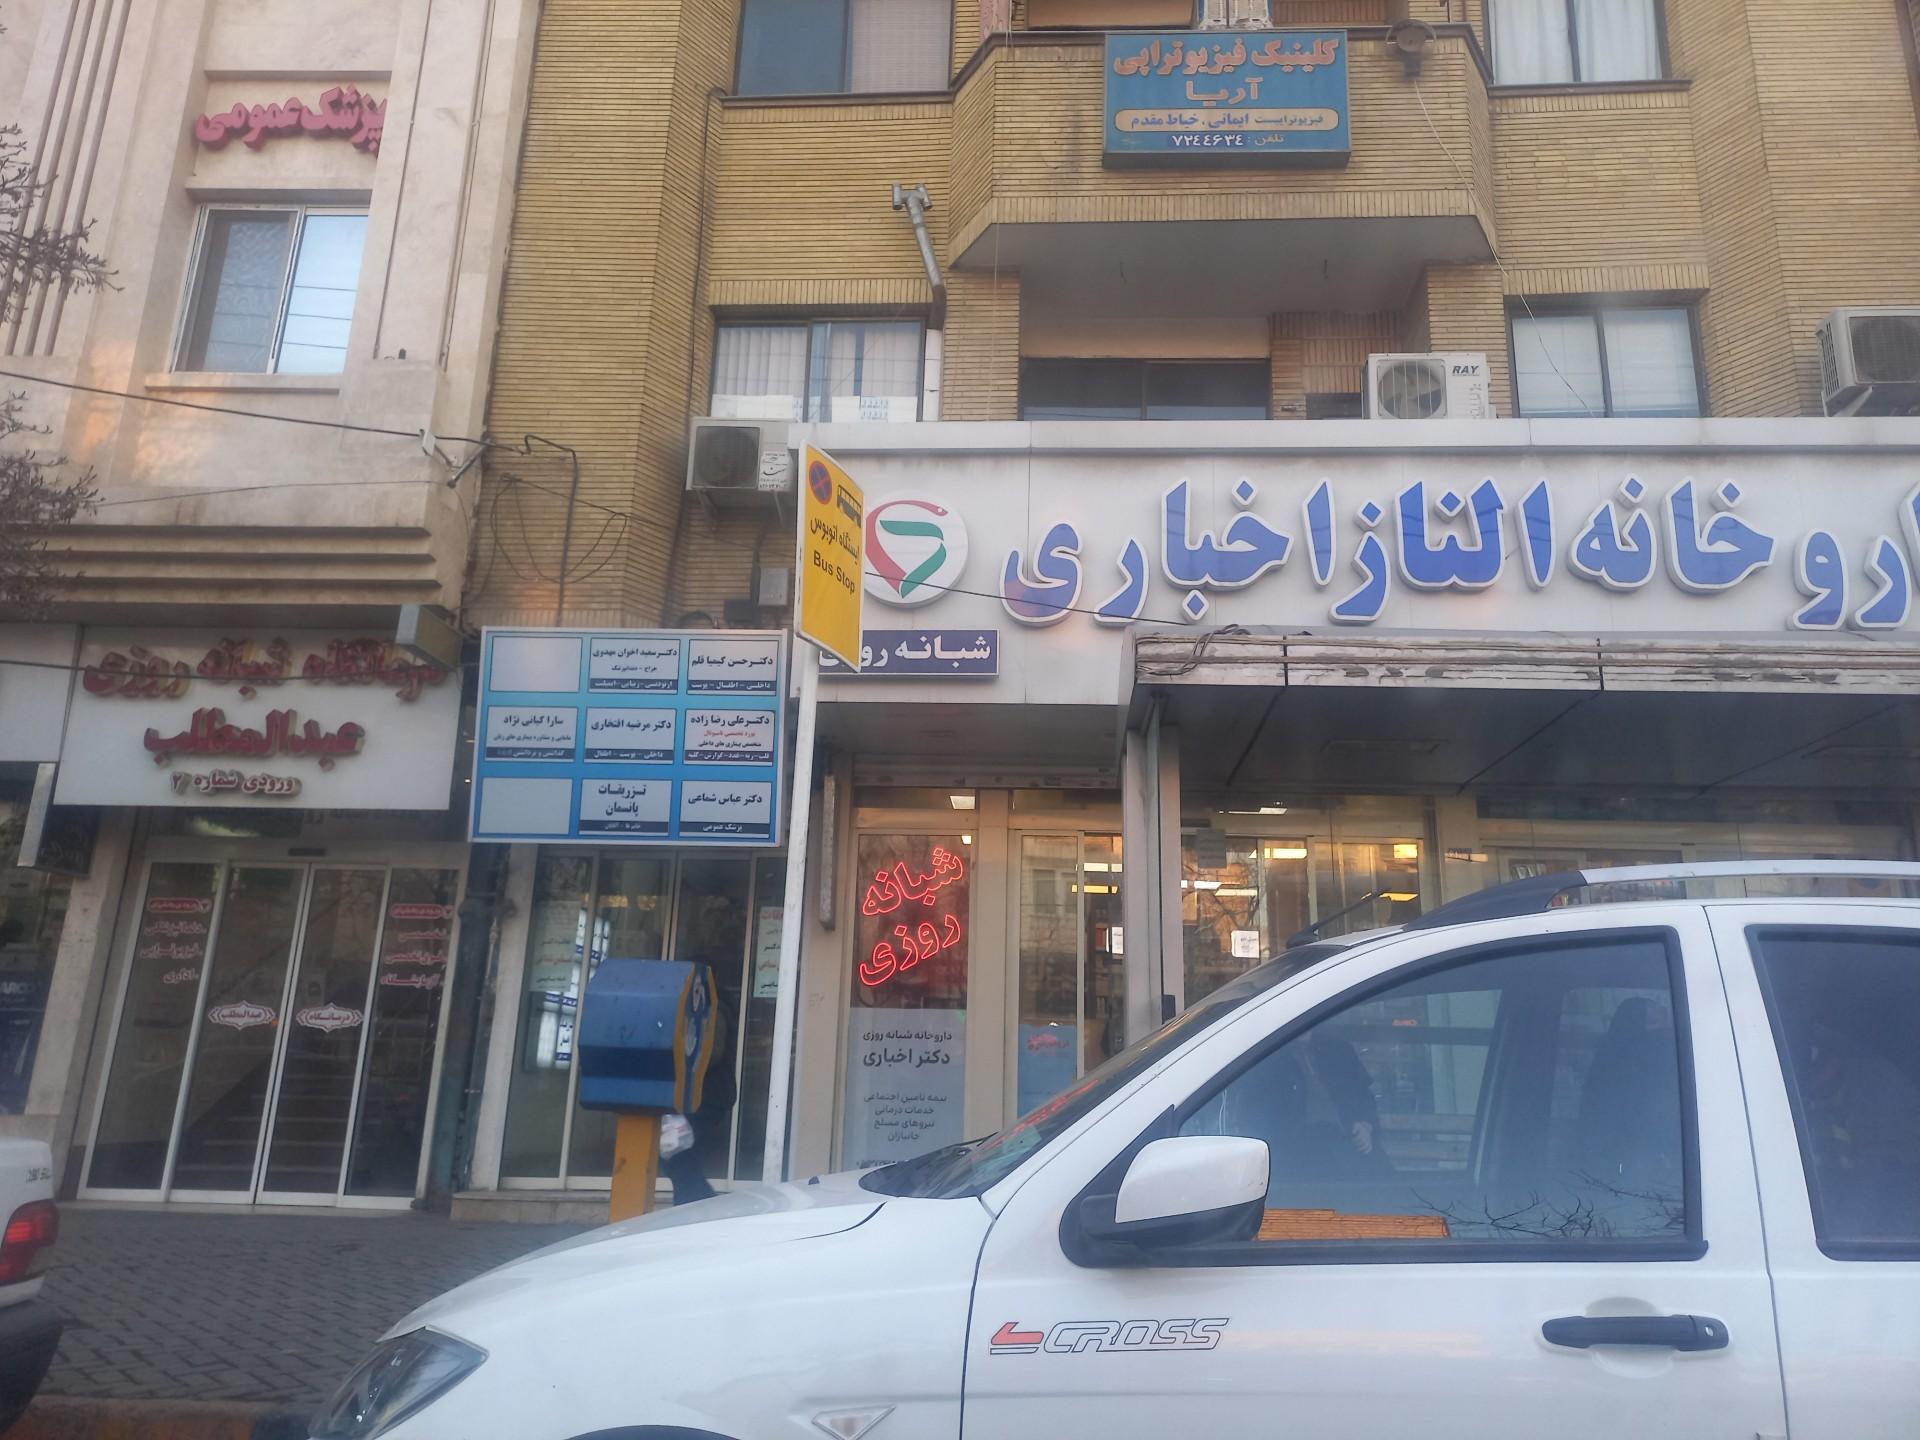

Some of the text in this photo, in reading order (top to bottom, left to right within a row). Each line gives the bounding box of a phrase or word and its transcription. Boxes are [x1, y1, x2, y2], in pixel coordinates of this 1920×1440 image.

[1113, 38, 1340, 77] کلینیک فیزیوتراپی
[1185, 77, 1264, 106] آریا
[195, 97, 303, 152] عمومی
[1131, 114, 1165, 129] مقدم
[1165, 113, 1200, 129] خیاط
[1452, 365, 1480, 374] RAY
[810, 517, 838, 545] اتوبوس
[1000, 474, 1337, 626] اخباری
[1328, 474, 1558, 624] الناز
[813, 549, 856, 594] Bus Stop
[894, 634, 992, 669] شبانه
[691, 654, 705, 667] قلم
[727, 658, 748, 668] حسن
[747, 656, 774, 668] دکتر
[591, 718, 624, 731] افتخاری
[652, 719, 672, 732] دکتر
[691, 715, 770, 727] دکتر علی رضا زاده
[143, 706, 366, 772] عبدالمطلب
[194, 769, 243, 793] شماره
[242, 774, 300, 796] ورودی
[598, 783, 647, 799] تزریقات
[718, 793, 742, 805] عباس
[743, 794, 763, 806] دکتر
[605, 801, 639, 816] پانسمان
[862, 847, 964, 917] شبانه
[859, 914, 962, 986] روزی
[863, 1030, 952, 1042] داروخانه شبانه روزی
[863, 1047, 951, 1068] دکتر اخباری
[863, 1092, 900, 1103] اجتماعی
[874, 1104, 935, 1116] خدمات درمانی
[873, 1118, 935, 1130] نیروهای مسلح
[1043, 1317, 1230, 1353] CROSS
